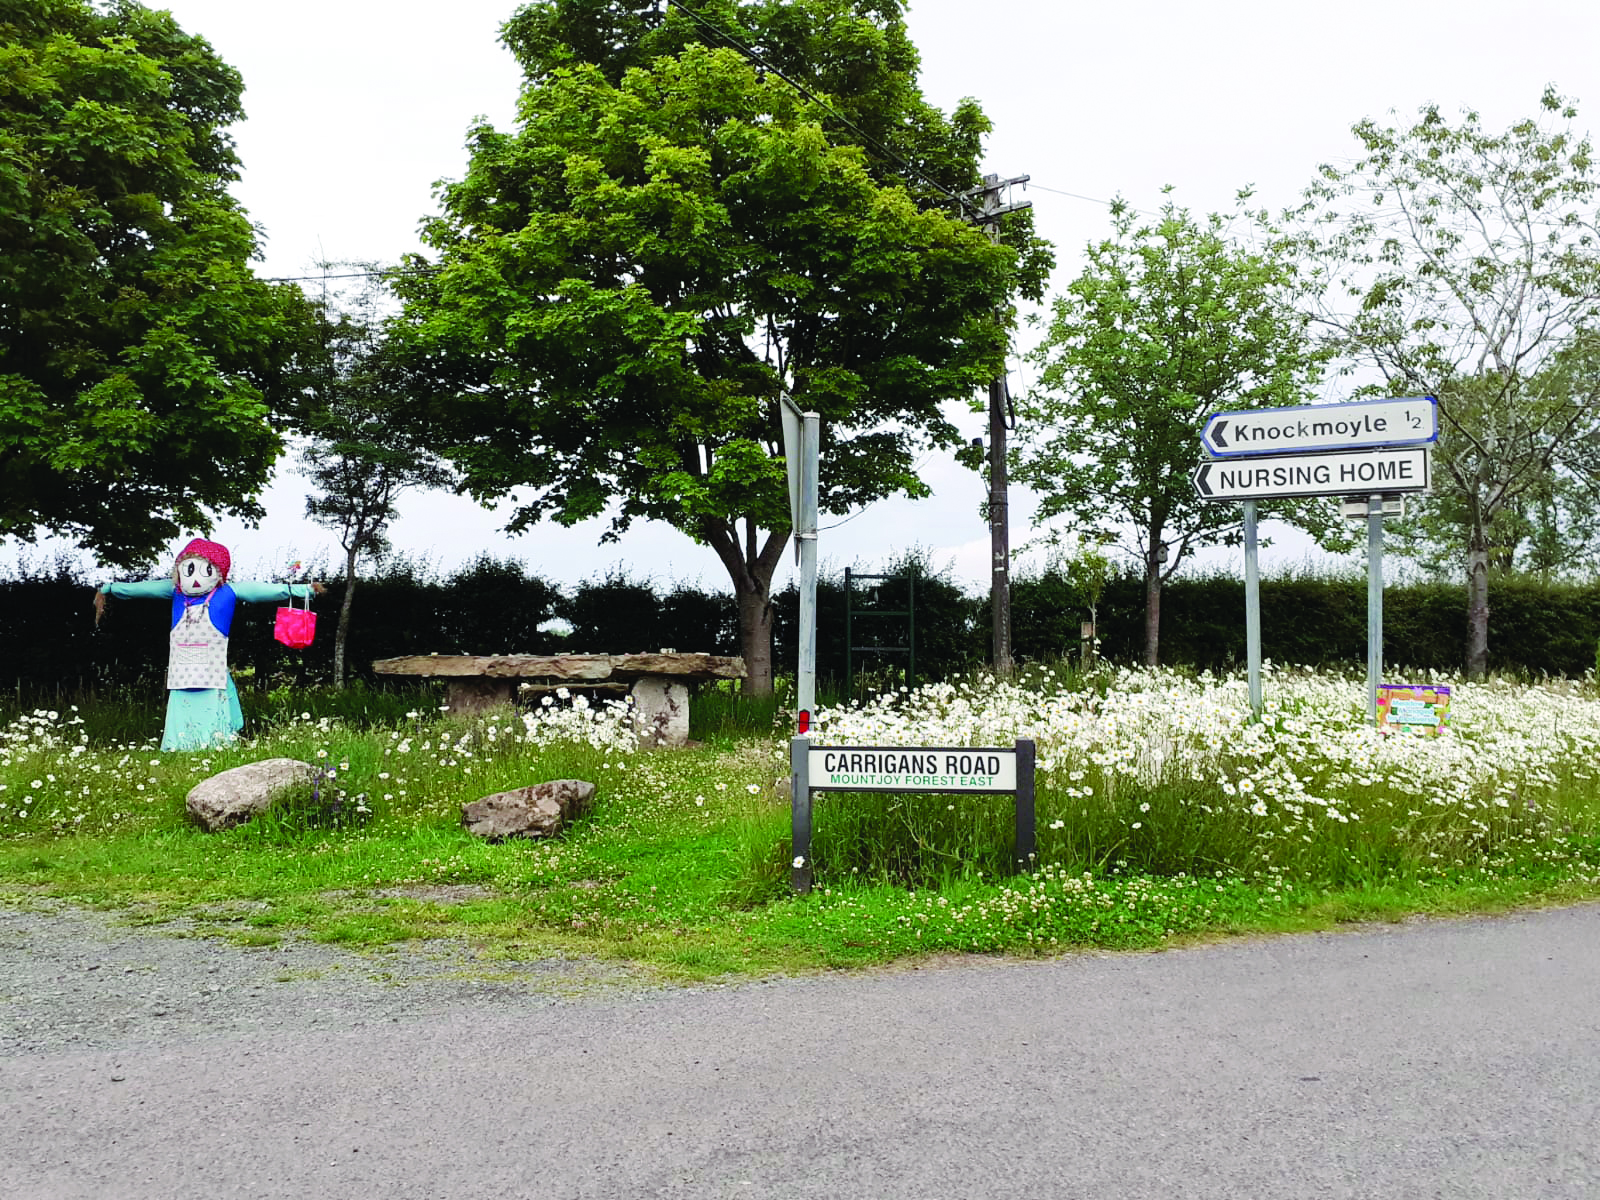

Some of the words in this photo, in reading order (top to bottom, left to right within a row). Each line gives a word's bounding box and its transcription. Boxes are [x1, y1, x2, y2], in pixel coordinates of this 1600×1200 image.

[1235, 415, 1387, 442] Knockmoyle
[1220, 465, 1330, 489] NURSING
[1340, 460, 1413, 483] HOME
[824, 753, 938, 774] CARRIGANS
[946, 756, 1000, 775] ROAD
[830, 774, 900, 785] MOUNTJOY
[905, 776, 955, 785] FOREST
[960, 777, 994, 786] EAST
